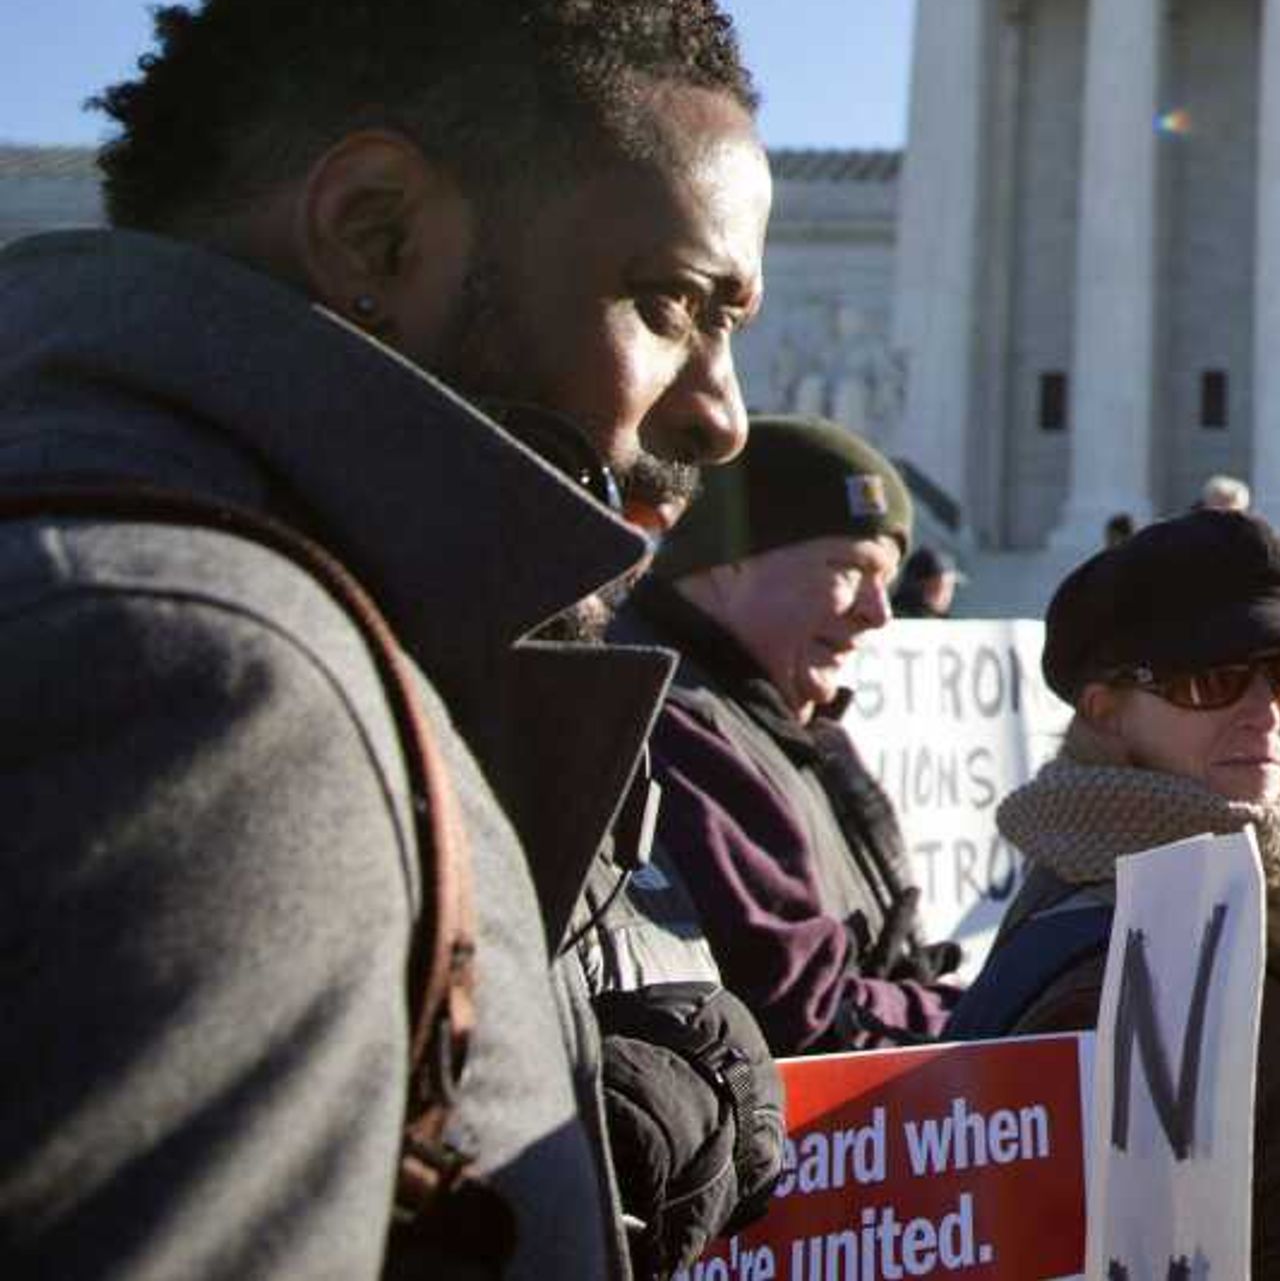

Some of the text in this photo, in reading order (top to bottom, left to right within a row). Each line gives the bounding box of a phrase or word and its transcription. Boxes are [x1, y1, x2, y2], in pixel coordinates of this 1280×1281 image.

[876, 744, 998, 813] IONS
[912, 836, 1018, 906] TRO
[773, 1097, 1049, 1197] eard when
[670, 1192, 993, 1281] 're united.
